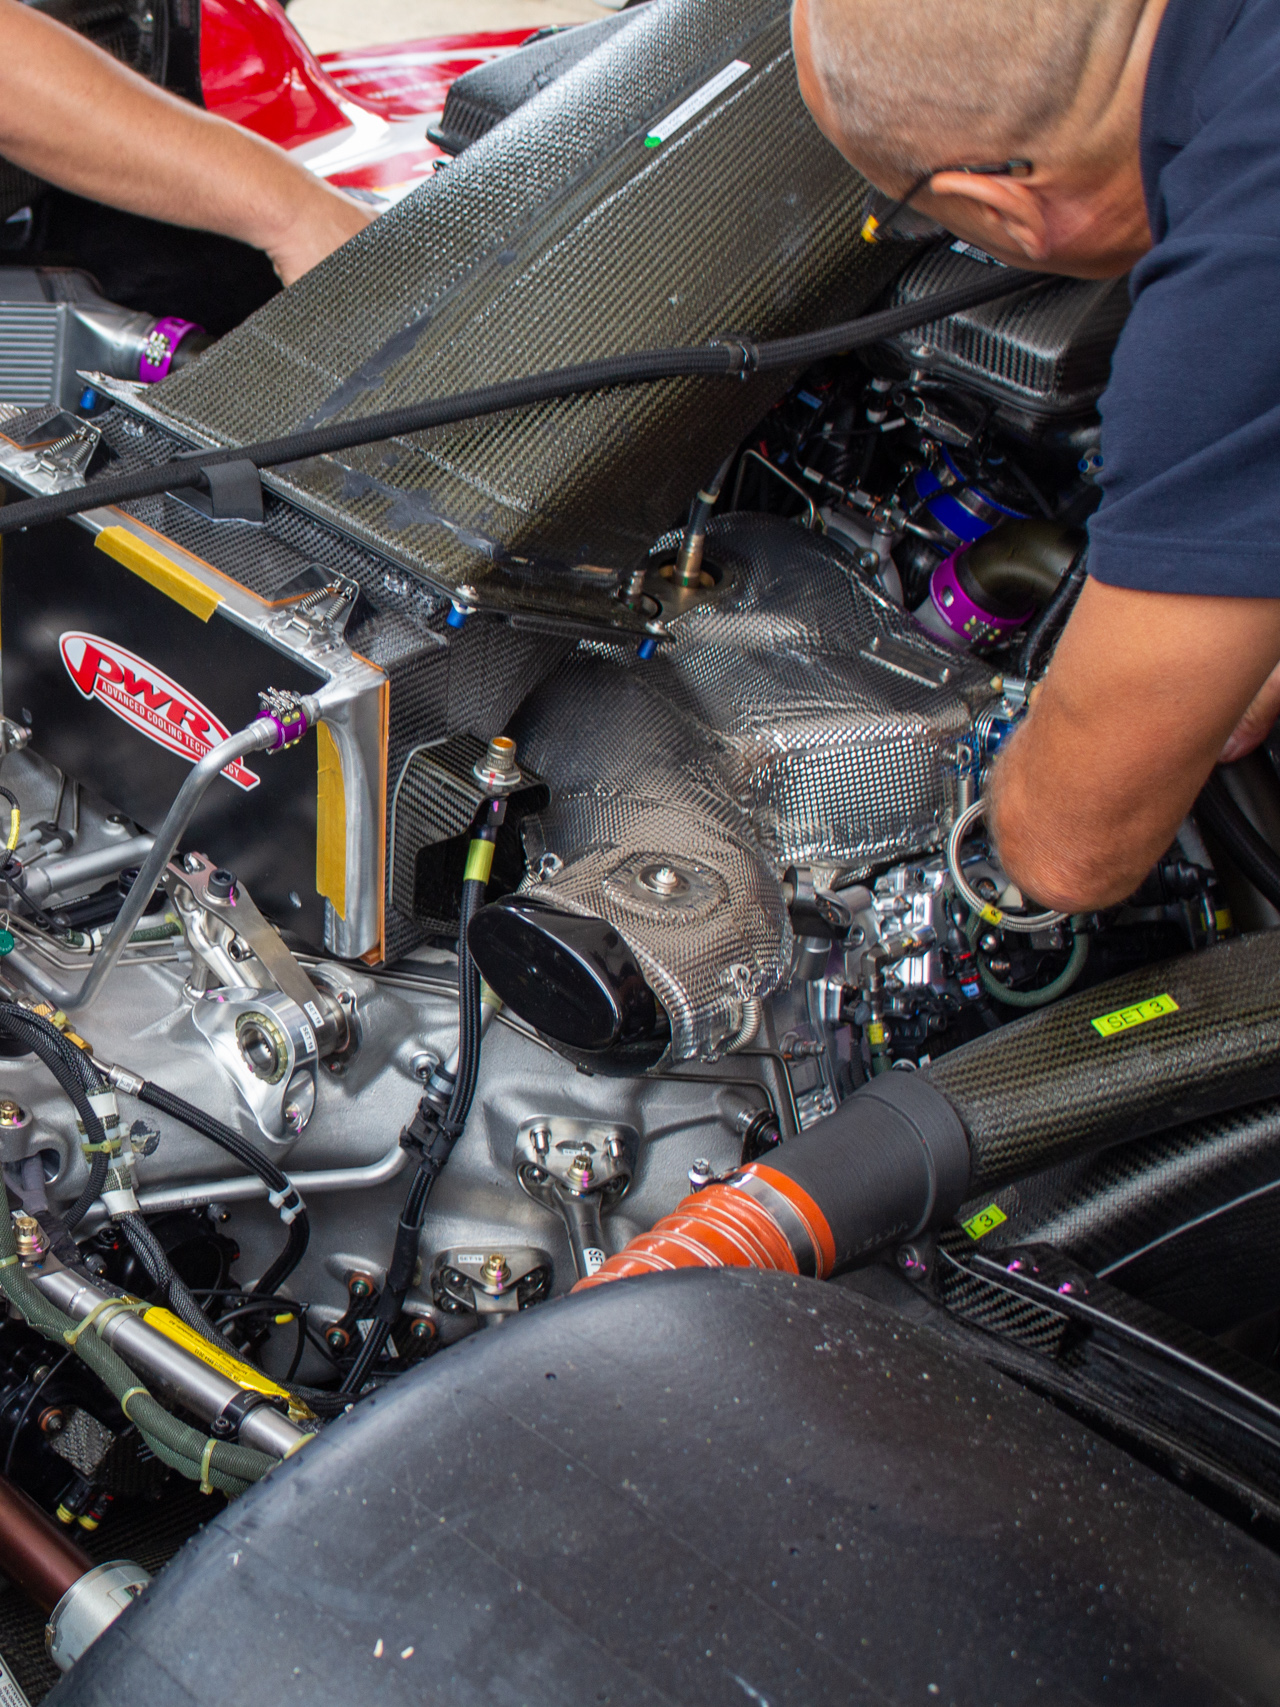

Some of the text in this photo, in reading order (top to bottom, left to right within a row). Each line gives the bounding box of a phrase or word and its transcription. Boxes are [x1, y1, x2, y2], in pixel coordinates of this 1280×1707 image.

[73, 640, 211, 740] PWR
[101, 680, 145, 717] ADVANCED
[147, 708, 183, 740] COOLING
[306, 1003, 321, 1024] SET 19
[1106, 999, 1164, 1029] SET 3
[302, 1026, 312, 1049] SET 19
[978, 1213, 994, 1228] 3
